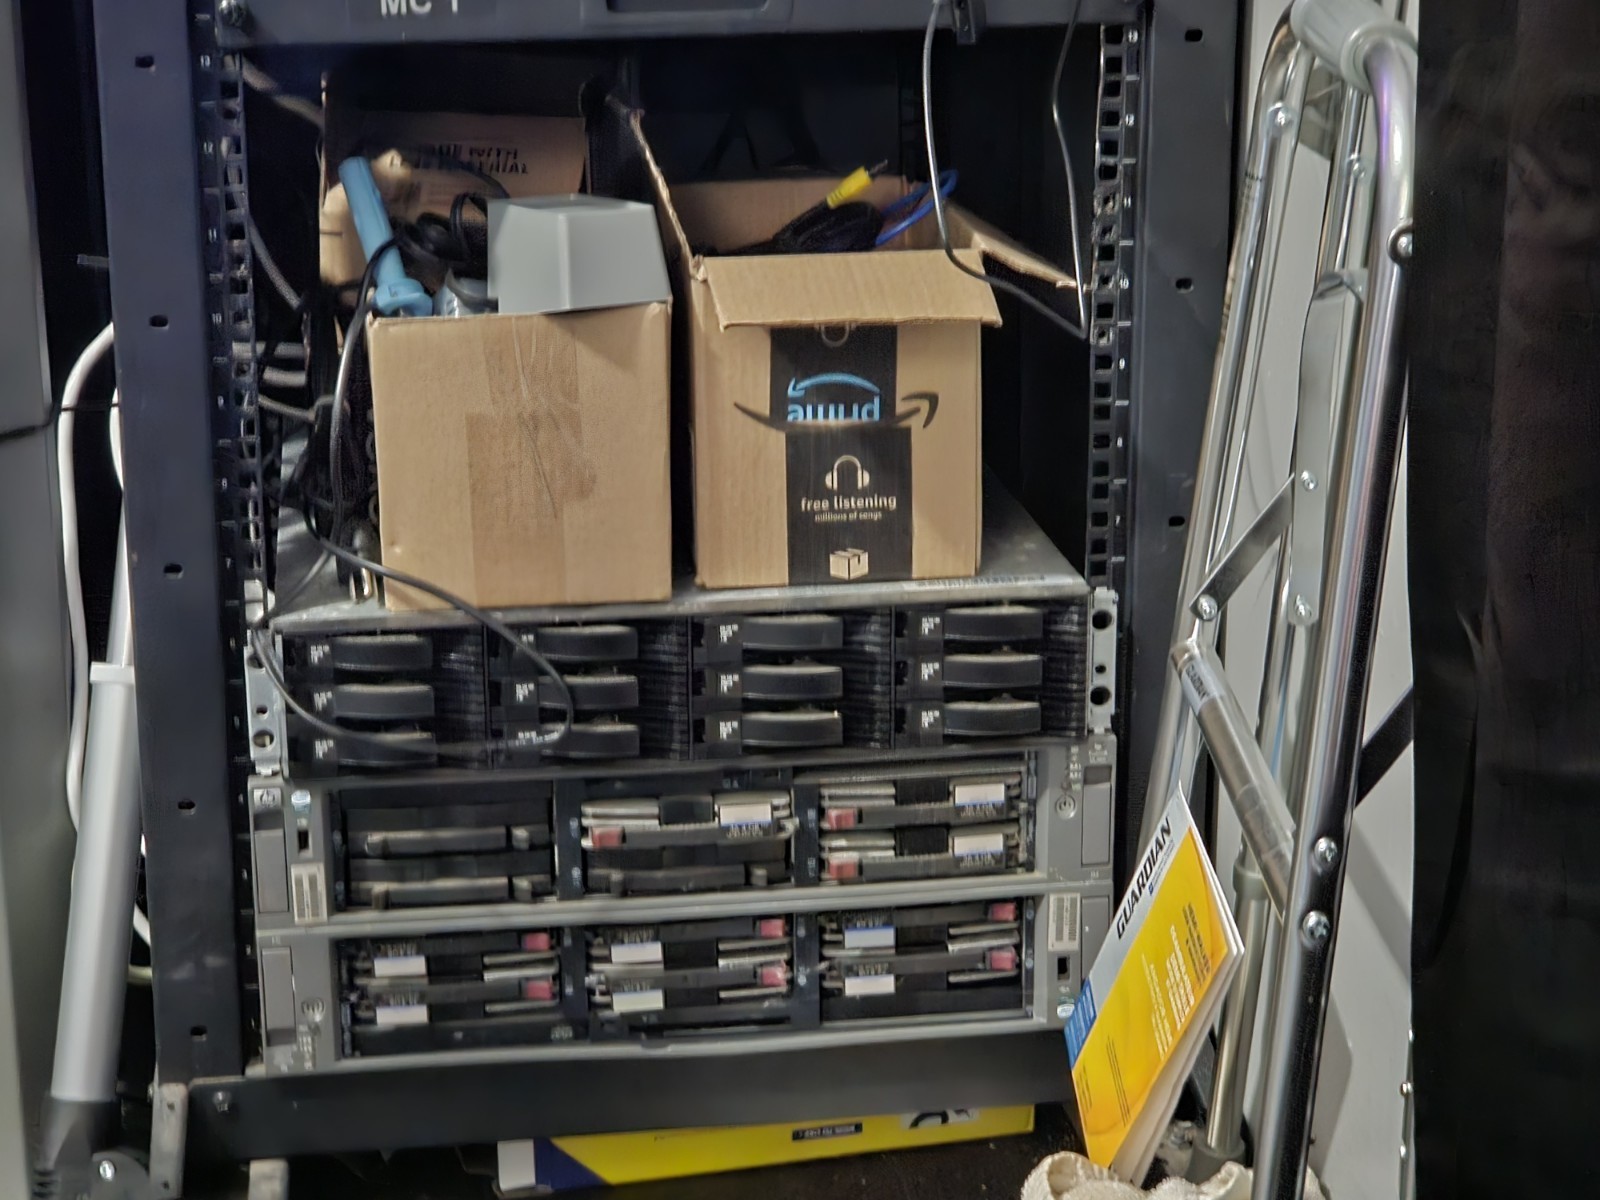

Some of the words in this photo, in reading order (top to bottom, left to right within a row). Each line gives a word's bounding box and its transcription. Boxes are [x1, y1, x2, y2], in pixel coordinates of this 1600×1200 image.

[801, 497, 829, 512] free
[834, 493, 897, 510] listening
[1116, 815, 1173, 940] GUARDIAN
